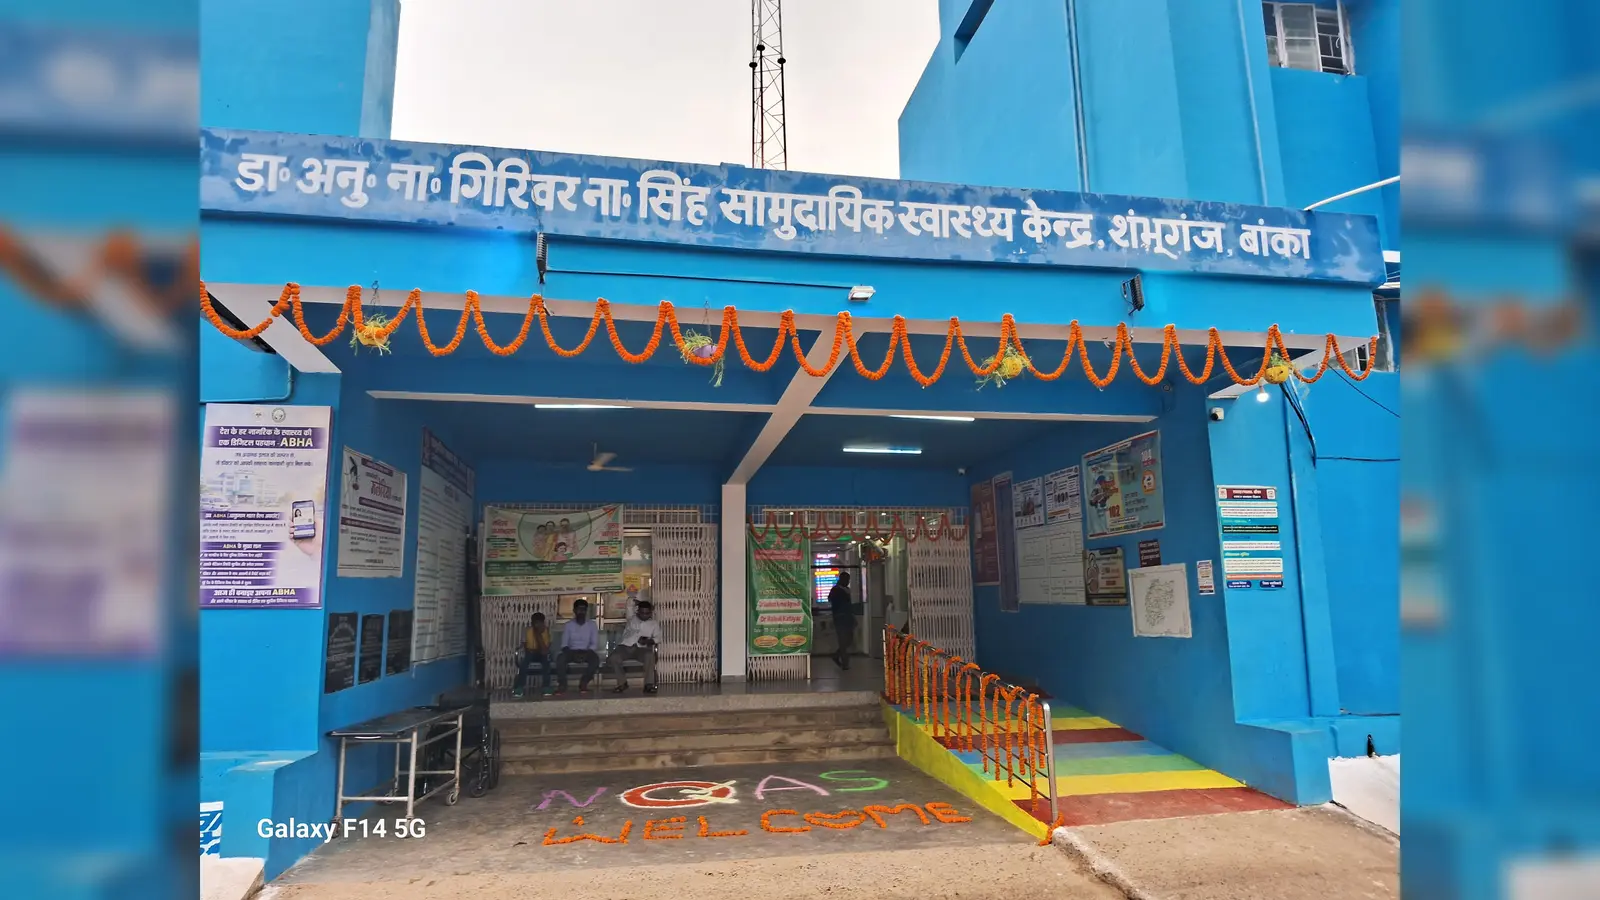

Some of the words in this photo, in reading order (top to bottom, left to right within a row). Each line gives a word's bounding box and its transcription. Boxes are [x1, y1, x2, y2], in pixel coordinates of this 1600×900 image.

[449, 152, 581, 211] गिरिवर
[637, 170, 711, 226] सिंह
[719, 185, 895, 240] सामुदायिक
[898, 201, 1017, 242] स्वास्थ्य
[1239, 218, 1311, 260] बांका
[280, 437, 313, 447] ABHA
